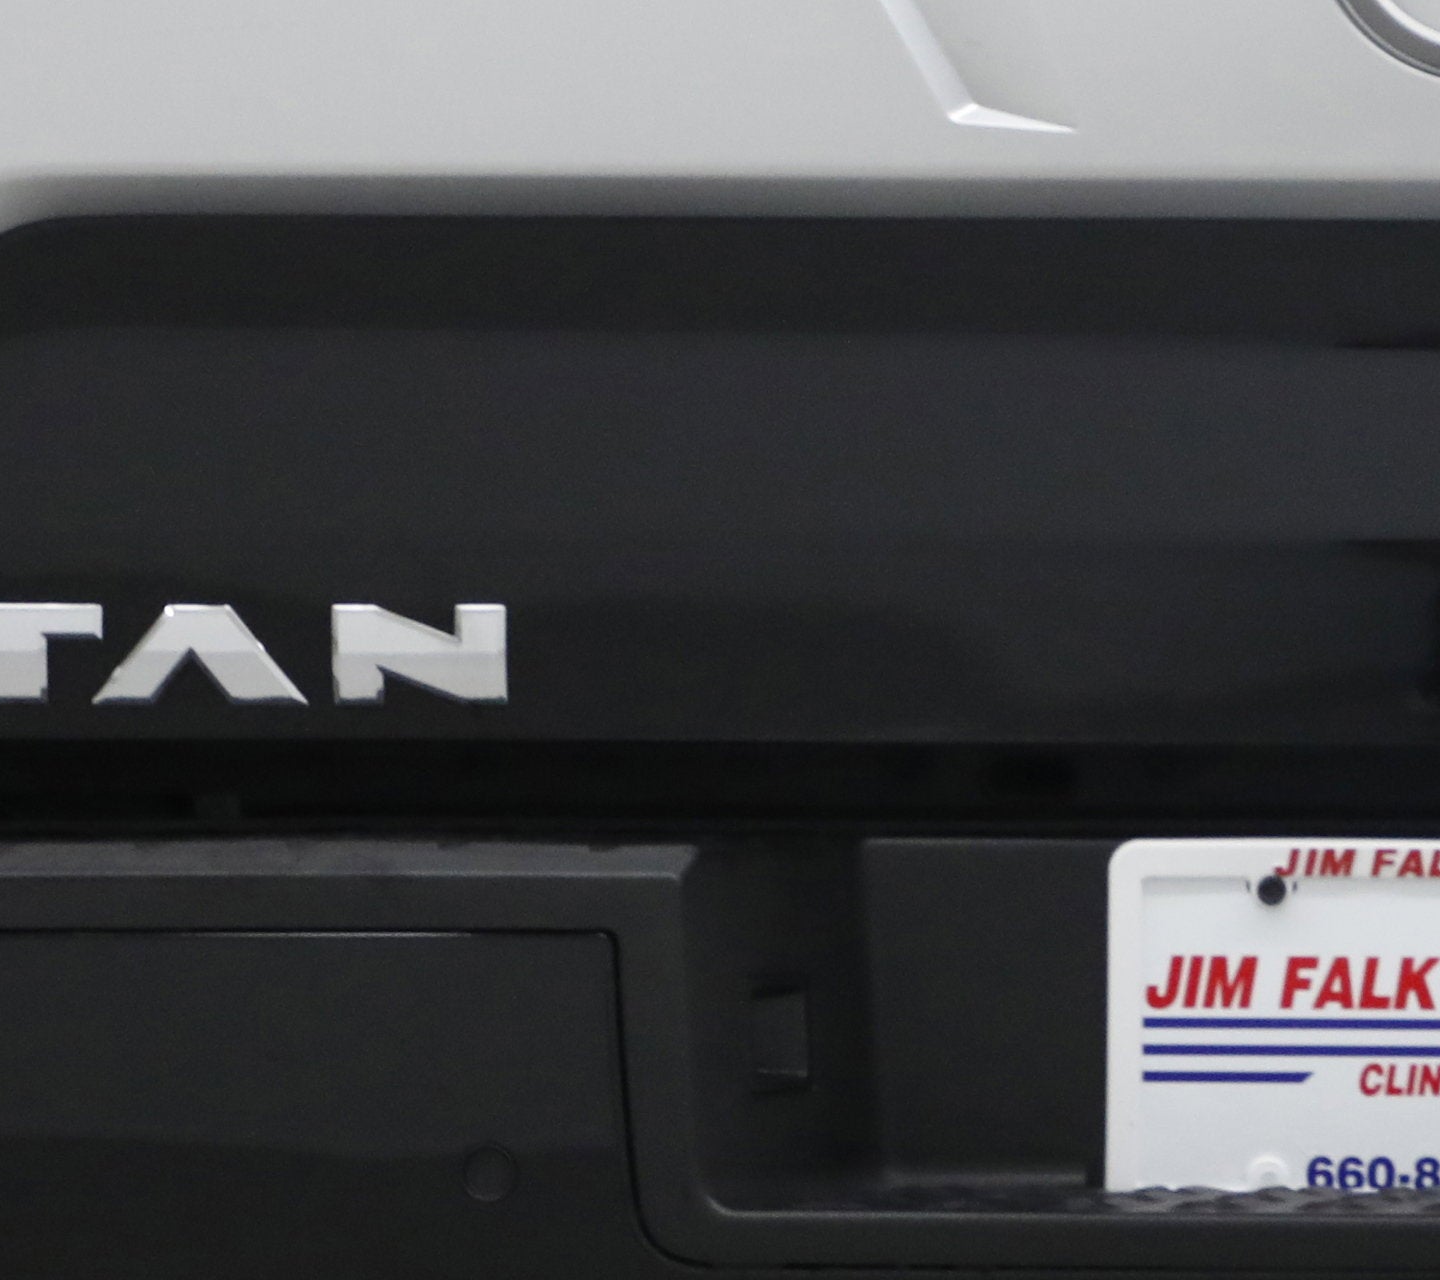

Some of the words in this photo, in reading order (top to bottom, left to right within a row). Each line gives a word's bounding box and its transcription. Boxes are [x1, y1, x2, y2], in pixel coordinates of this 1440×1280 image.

[1274, 847, 1356, 877] JIM
[1146, 955, 1258, 1010] JIM
[1279, 956, 1440, 1011] FALK
